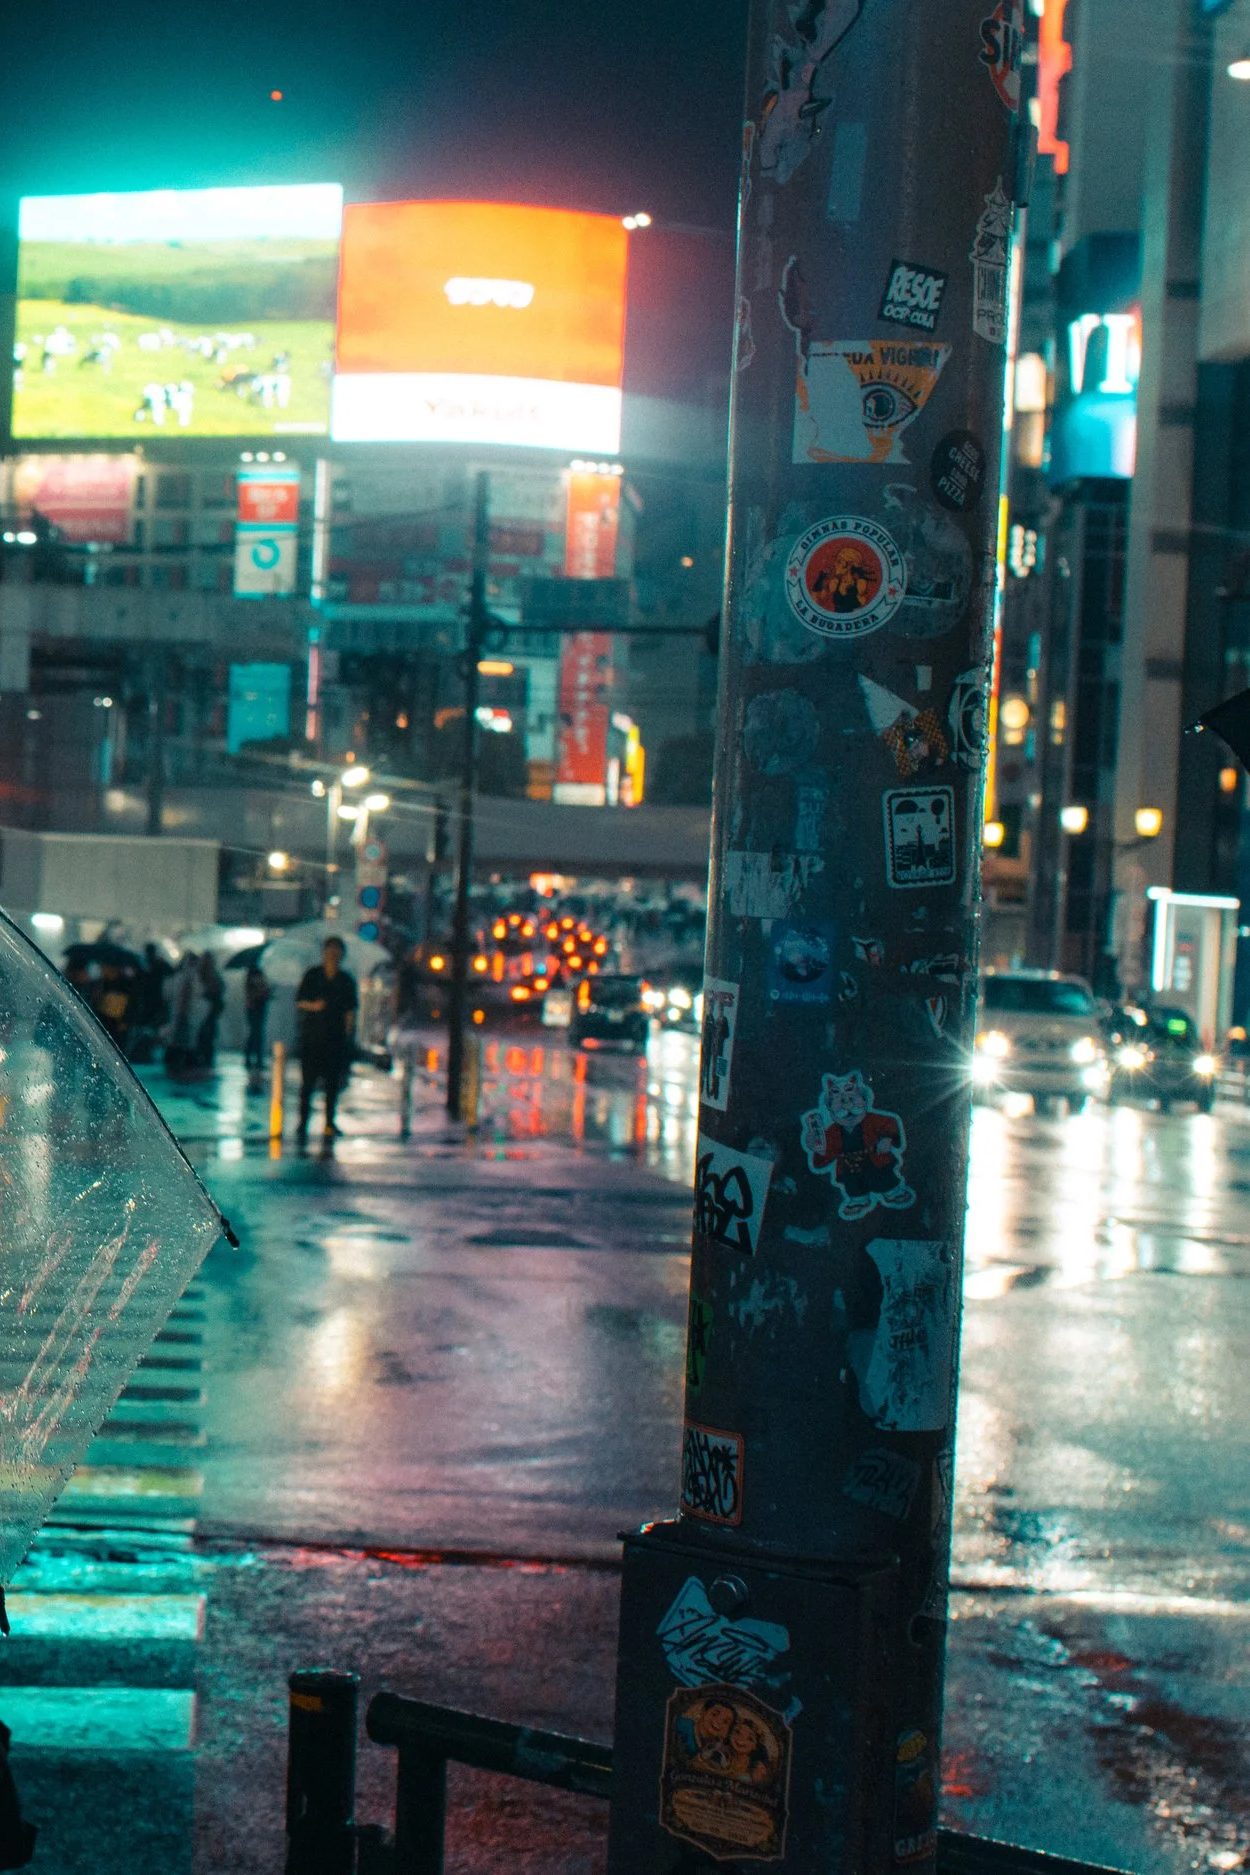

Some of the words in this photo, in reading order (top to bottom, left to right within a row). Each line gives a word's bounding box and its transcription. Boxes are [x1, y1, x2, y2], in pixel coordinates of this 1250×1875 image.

[938, 476, 966, 506] PIZZA
[853, 522, 899, 567] POPULAR
[795, 600, 808, 616] LA
